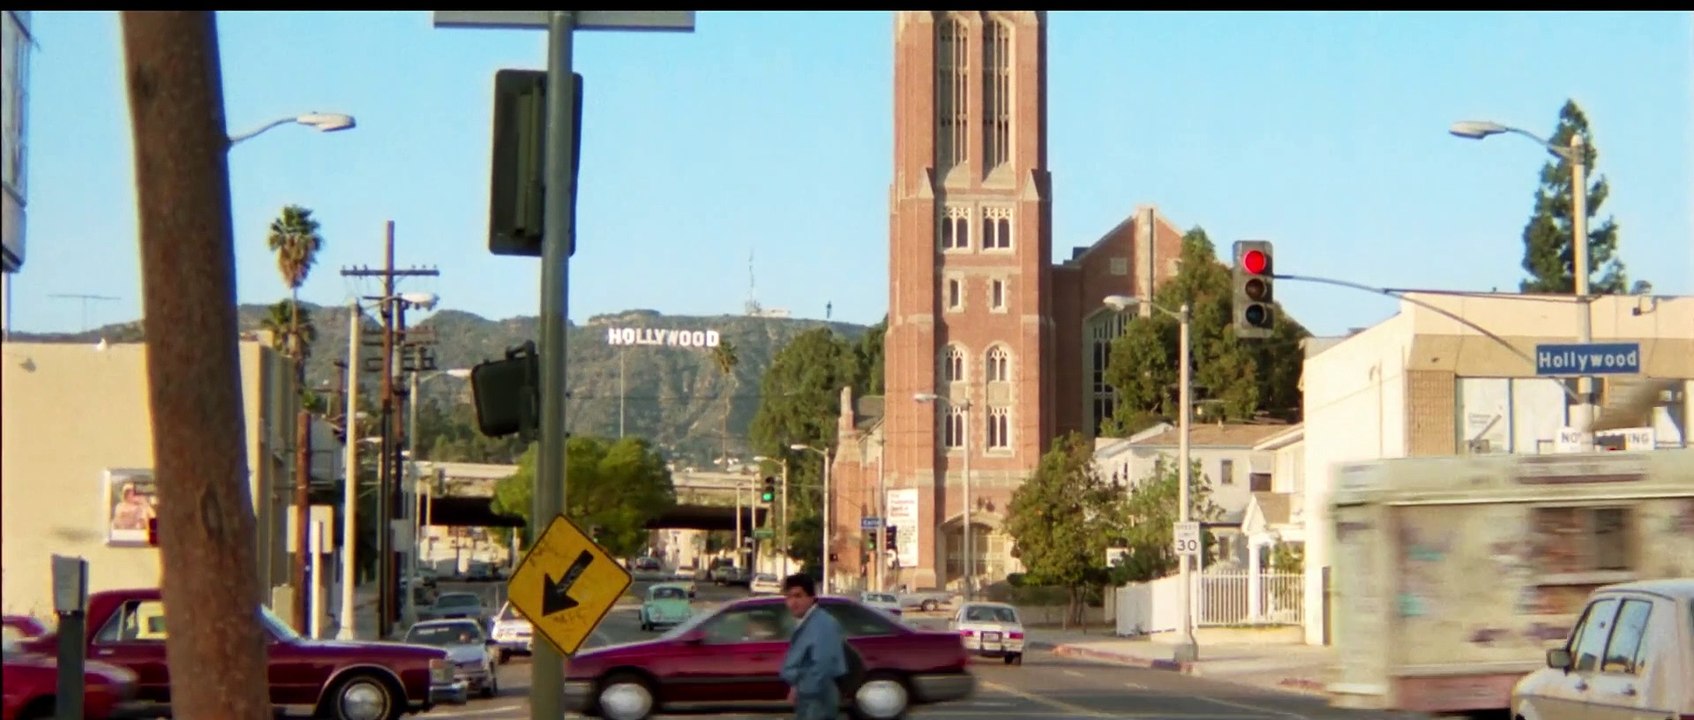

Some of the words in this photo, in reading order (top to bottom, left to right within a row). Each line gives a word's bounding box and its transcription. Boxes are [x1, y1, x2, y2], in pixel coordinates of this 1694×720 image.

[608, 328, 720, 346] HOLLYWOOD
[1539, 350, 1637, 371] Hollywood
[1177, 540, 1197, 551] 30
